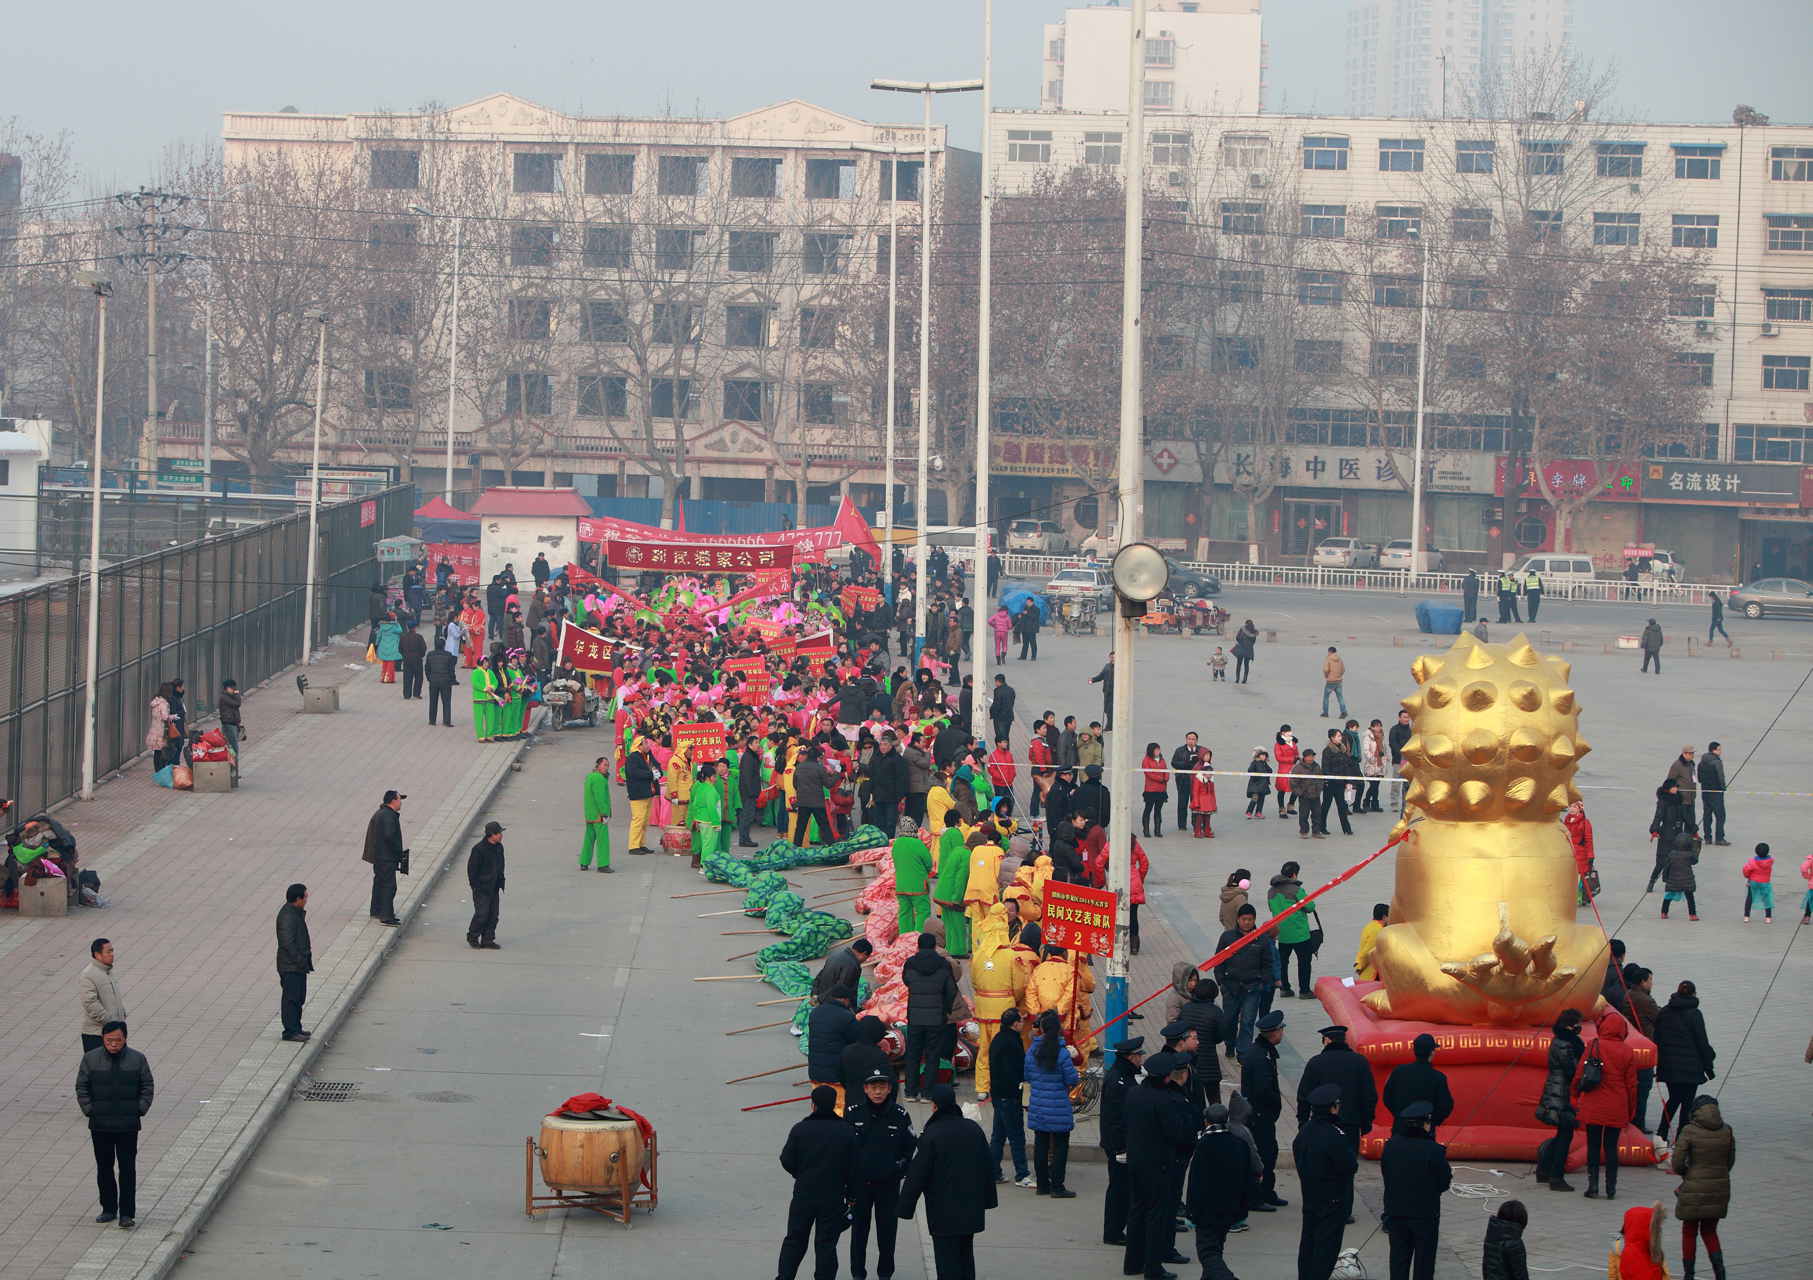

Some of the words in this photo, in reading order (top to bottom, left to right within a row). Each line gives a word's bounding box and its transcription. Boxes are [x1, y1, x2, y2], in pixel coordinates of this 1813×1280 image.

[1235, 453, 1436, 482] 长海中医诊
[1669, 472, 1741, 493] 名流设计
[1047, 904, 1111, 928] 民间文艺表演队
[1073, 931, 1082, 946] 2
